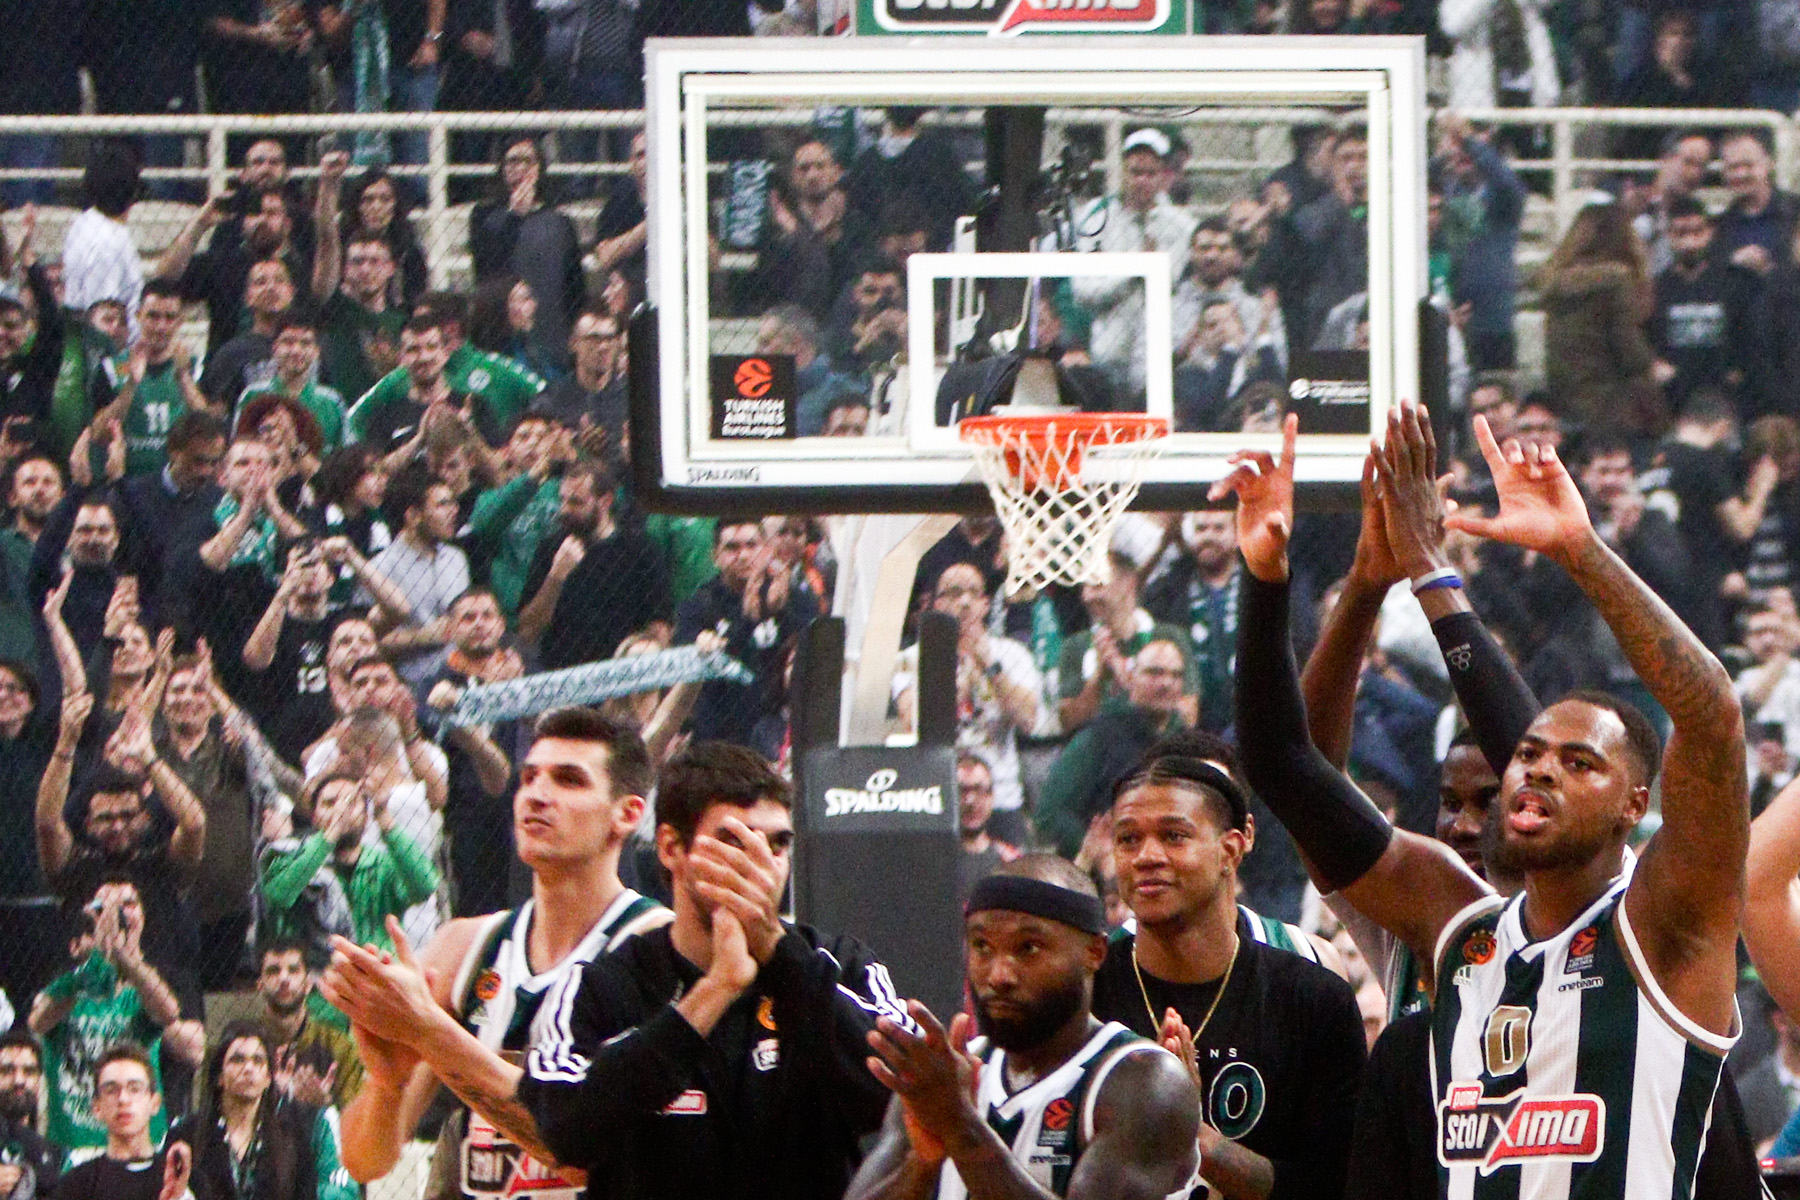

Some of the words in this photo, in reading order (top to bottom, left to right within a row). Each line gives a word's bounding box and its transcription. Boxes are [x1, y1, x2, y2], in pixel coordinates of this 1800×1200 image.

[722, 399, 786, 413] TURKISH
[686, 464, 761, 485] SPALDING
[824, 785, 945, 817] SPALDING
[1557, 976, 1604, 993] oneteam
[1485, 1004, 1533, 1078] 0
